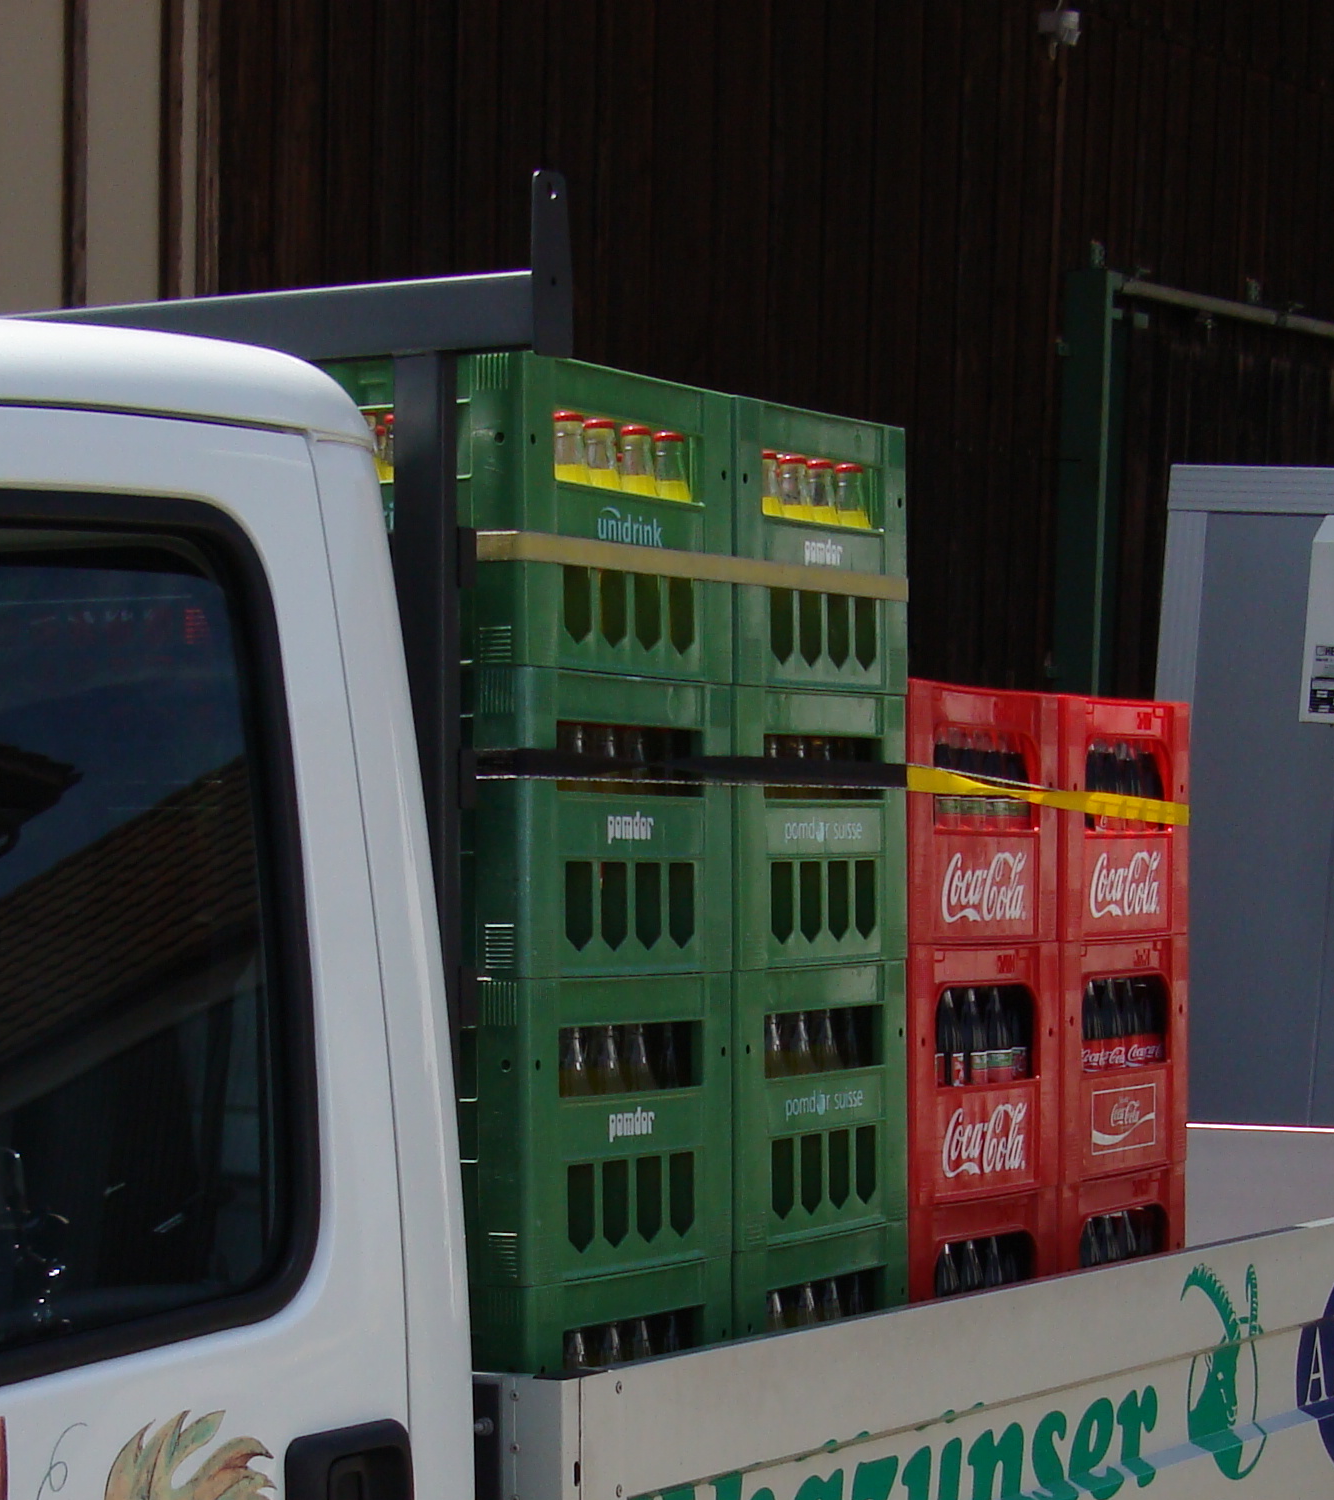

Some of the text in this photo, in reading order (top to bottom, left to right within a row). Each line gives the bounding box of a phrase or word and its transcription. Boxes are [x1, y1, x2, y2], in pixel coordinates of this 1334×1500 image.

[597, 507, 664, 548] unidrink
[607, 811, 655, 844] pomdor
[833, 820, 863, 840] suisse
[941, 852, 1027, 923] Coca-Cola
[1089, 852, 1162, 919] Coca-Cola
[834, 1089, 864, 1111] suisse
[609, 1106, 655, 1142] pomdor
[942, 1102, 1028, 1178] Coca-Cola
